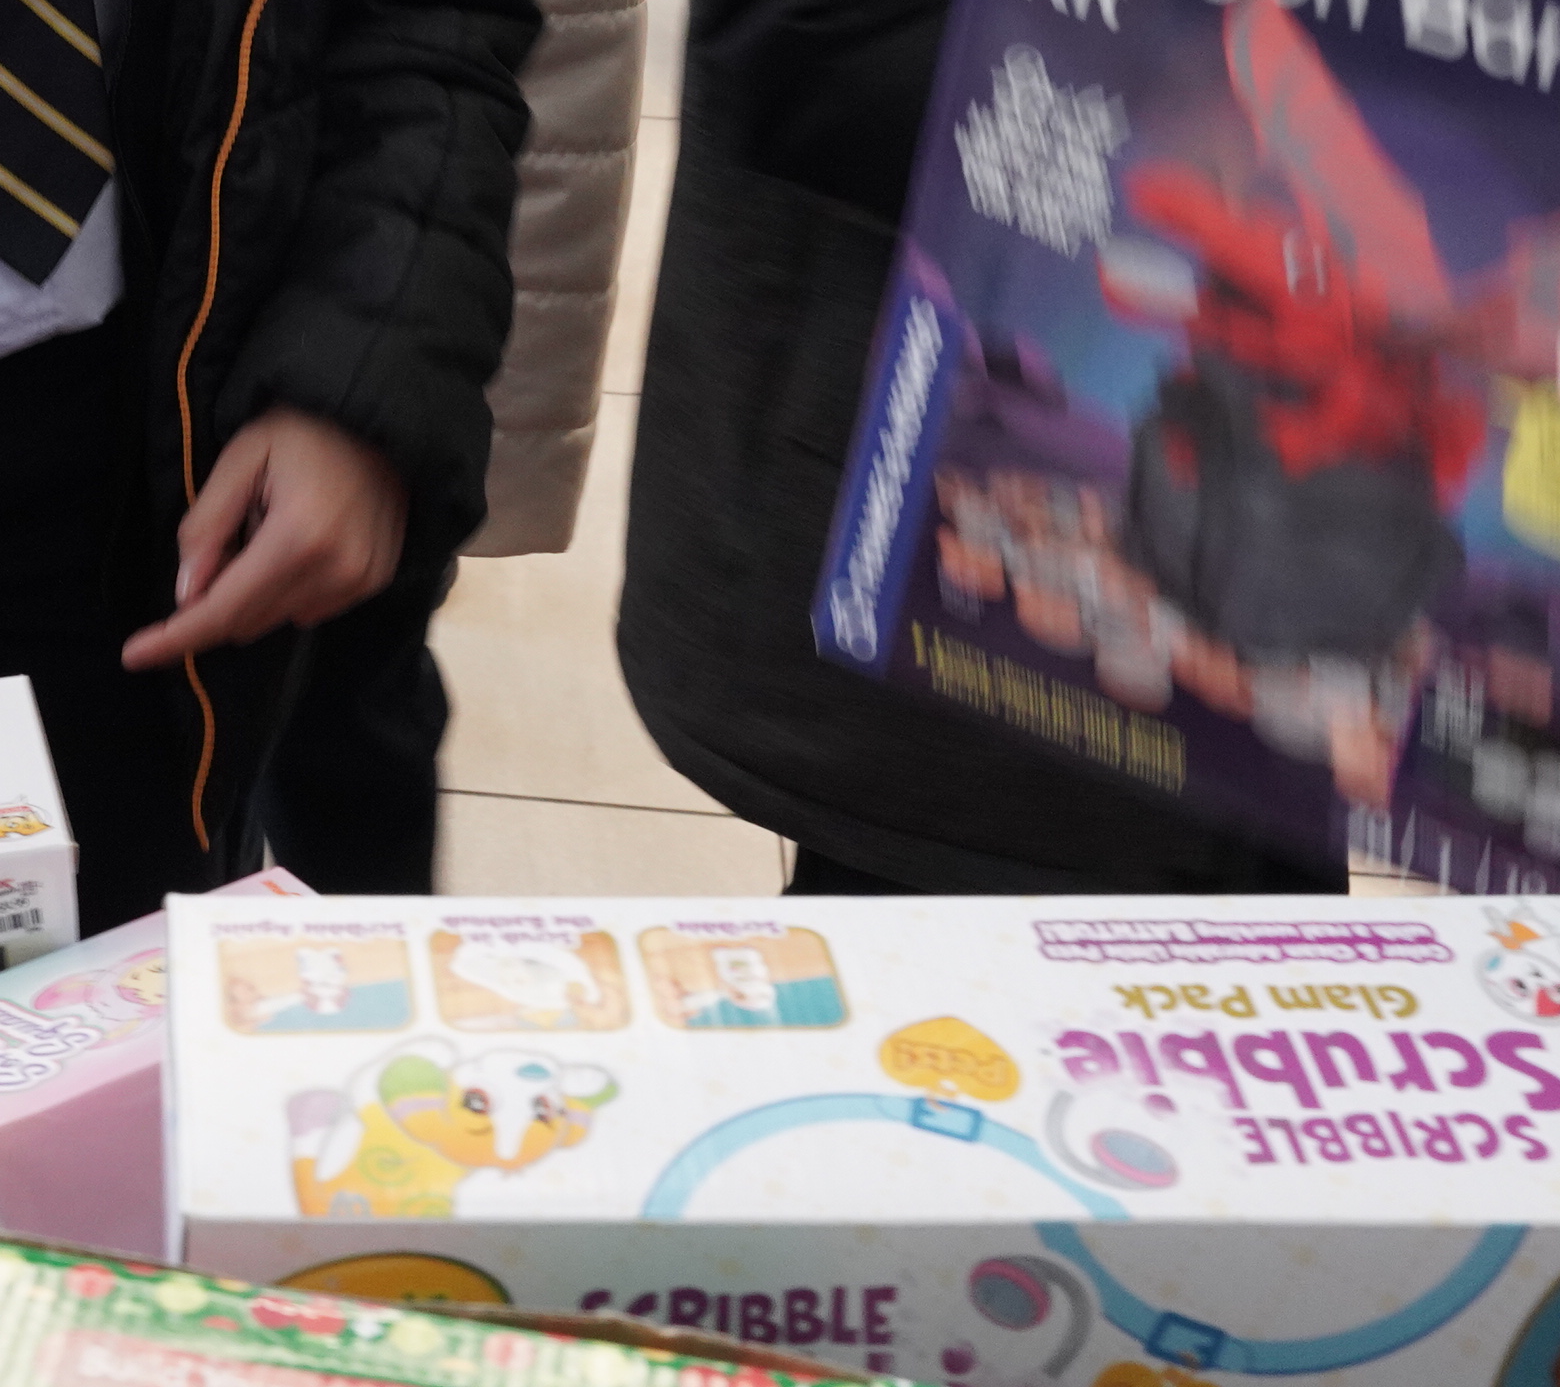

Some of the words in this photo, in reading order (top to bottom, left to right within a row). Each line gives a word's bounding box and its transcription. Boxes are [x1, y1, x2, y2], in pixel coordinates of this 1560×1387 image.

[1112, 982, 1253, 1020] Pack
[1267, 983, 1420, 1020] Glam
[1231, 1112, 1551, 1167] SCRIBBLE
